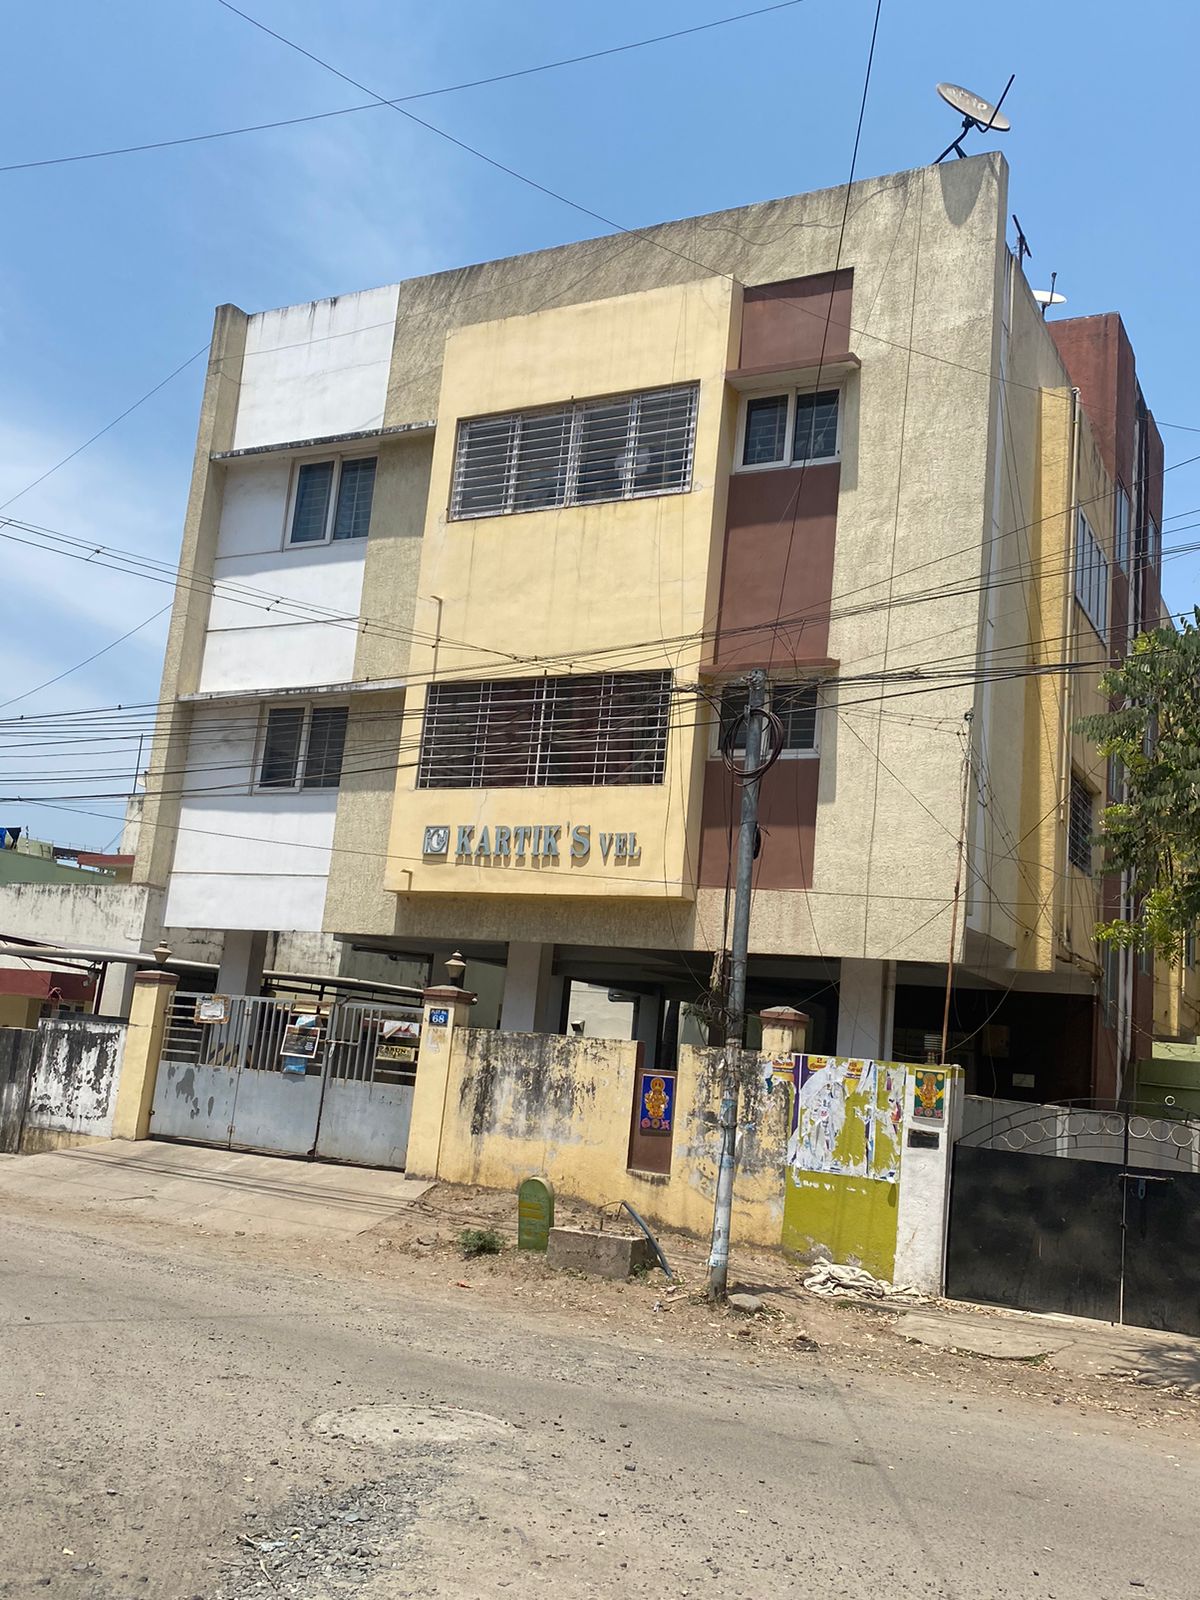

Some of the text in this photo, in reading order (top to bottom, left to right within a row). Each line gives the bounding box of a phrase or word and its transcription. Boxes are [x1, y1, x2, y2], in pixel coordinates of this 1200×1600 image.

[454, 821, 642, 858] KARTIK'S VEL
[432, 1014, 445, 1024] 68
